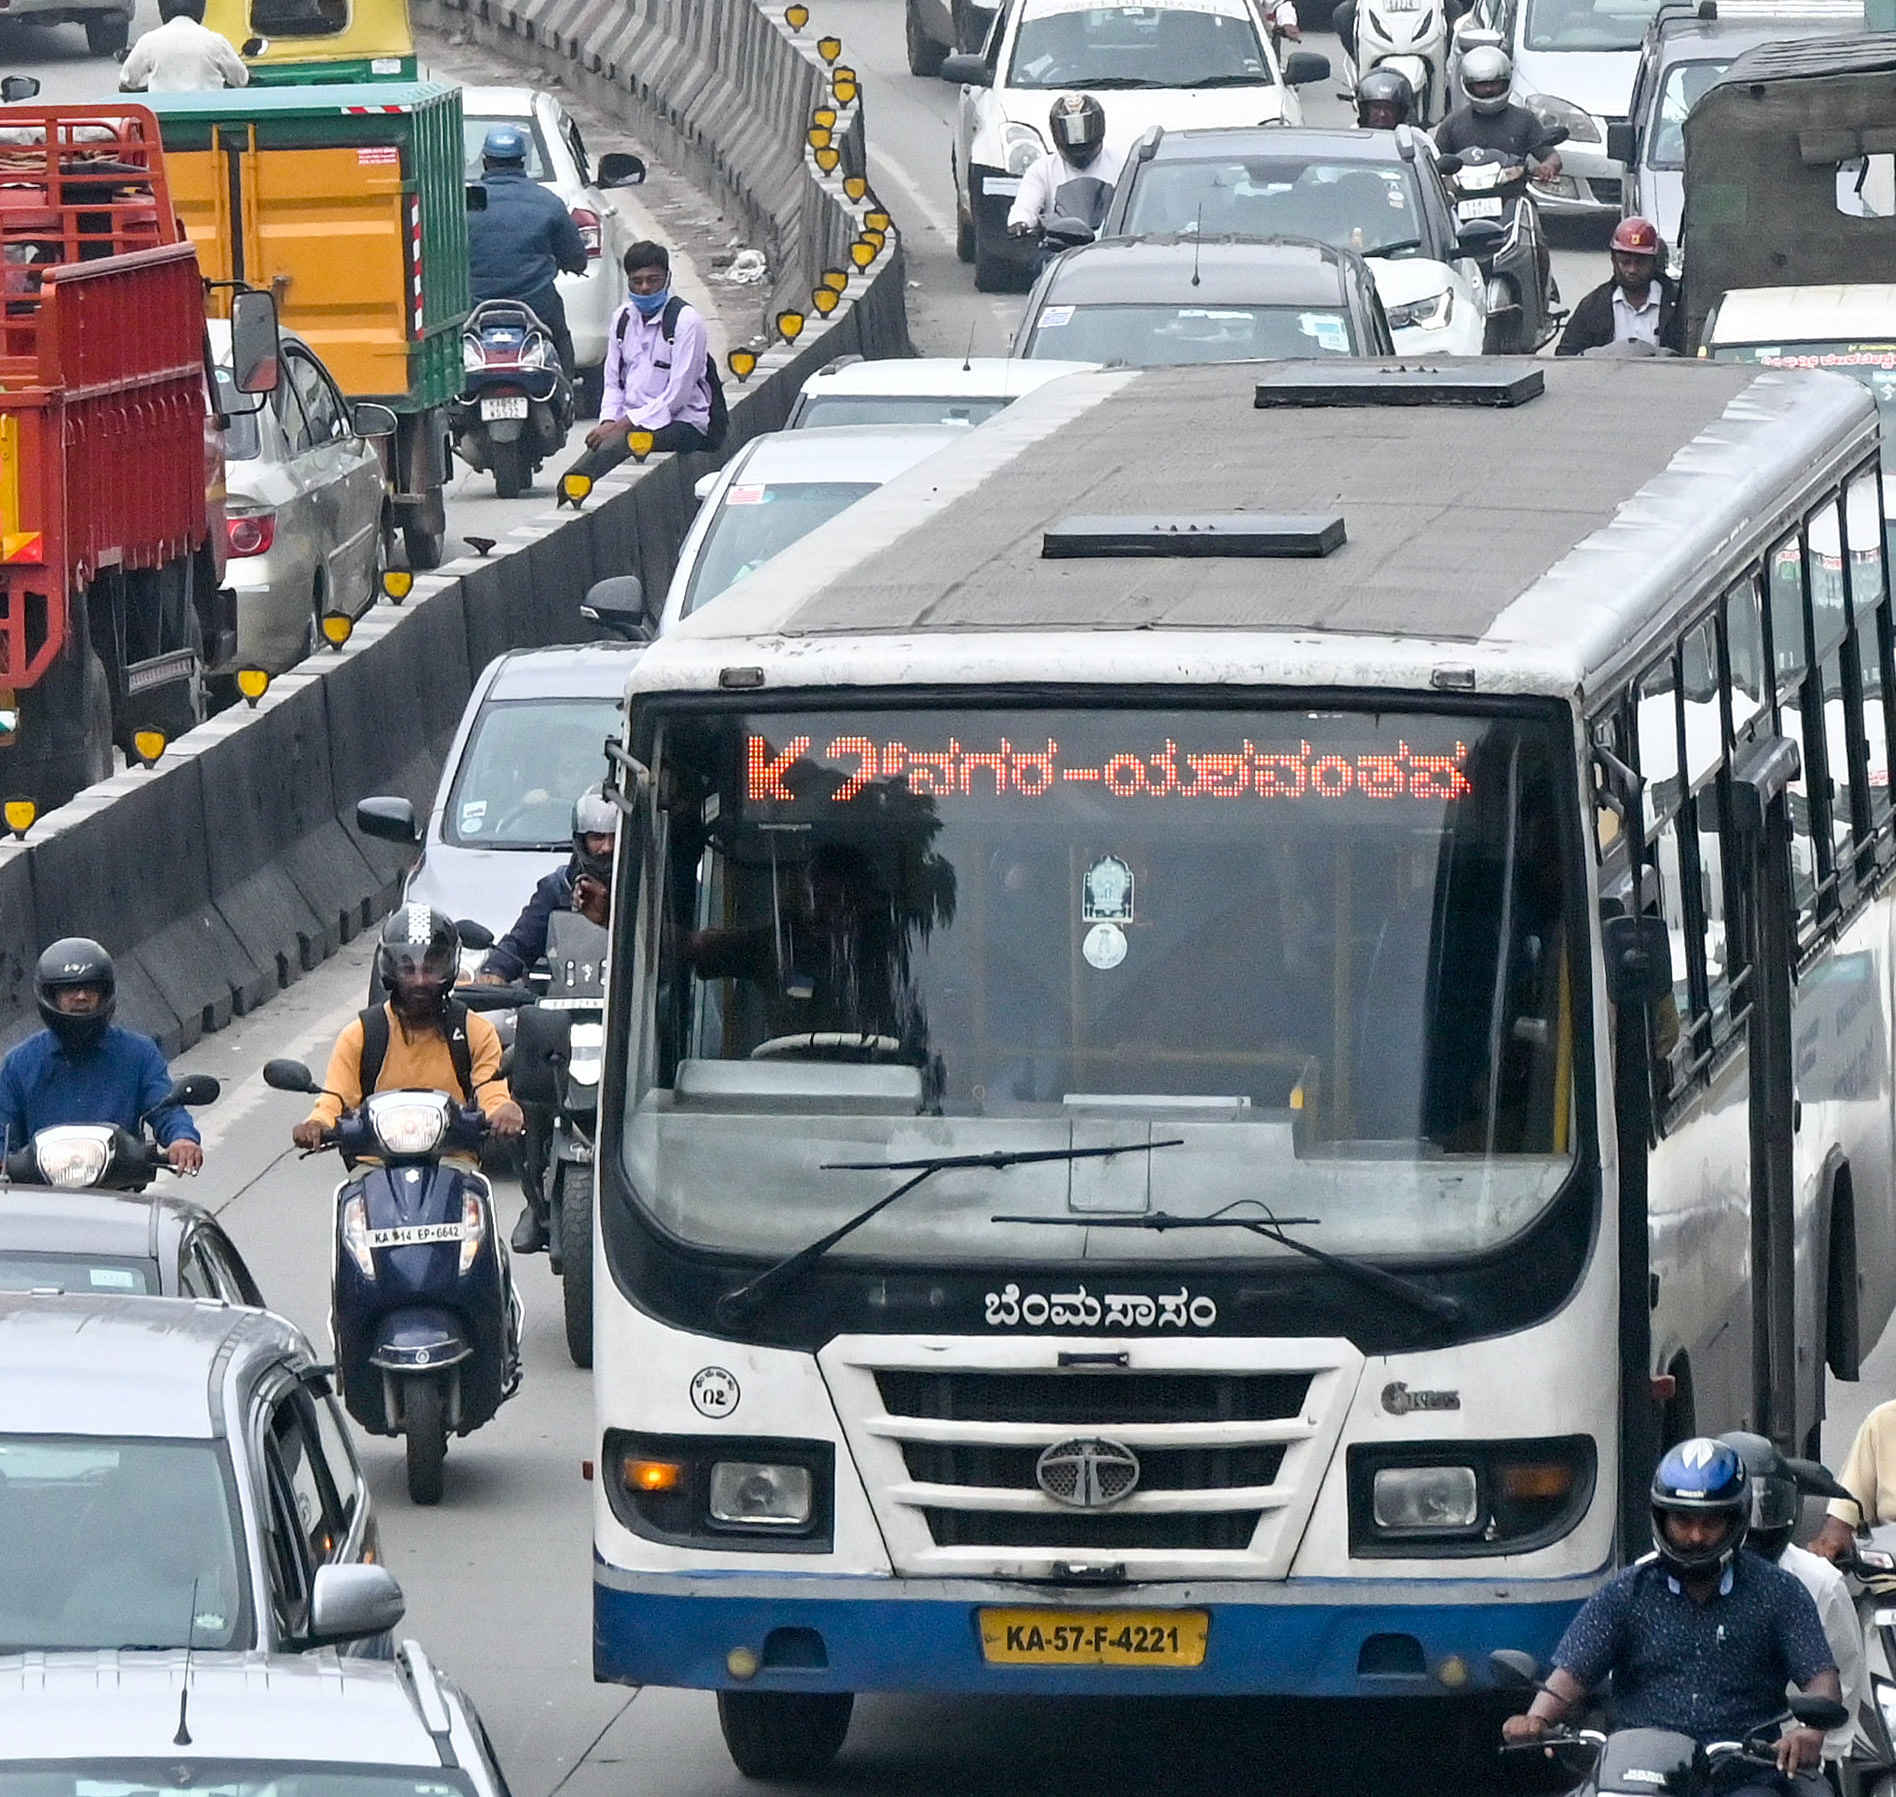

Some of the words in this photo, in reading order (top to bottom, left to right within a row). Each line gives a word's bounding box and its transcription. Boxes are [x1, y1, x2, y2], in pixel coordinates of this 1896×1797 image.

[375, 1232, 389, 1244] KA
[401, 1229, 412, 1241] 14
[1006, 1625, 1179, 1653] KA-57-F-4221
